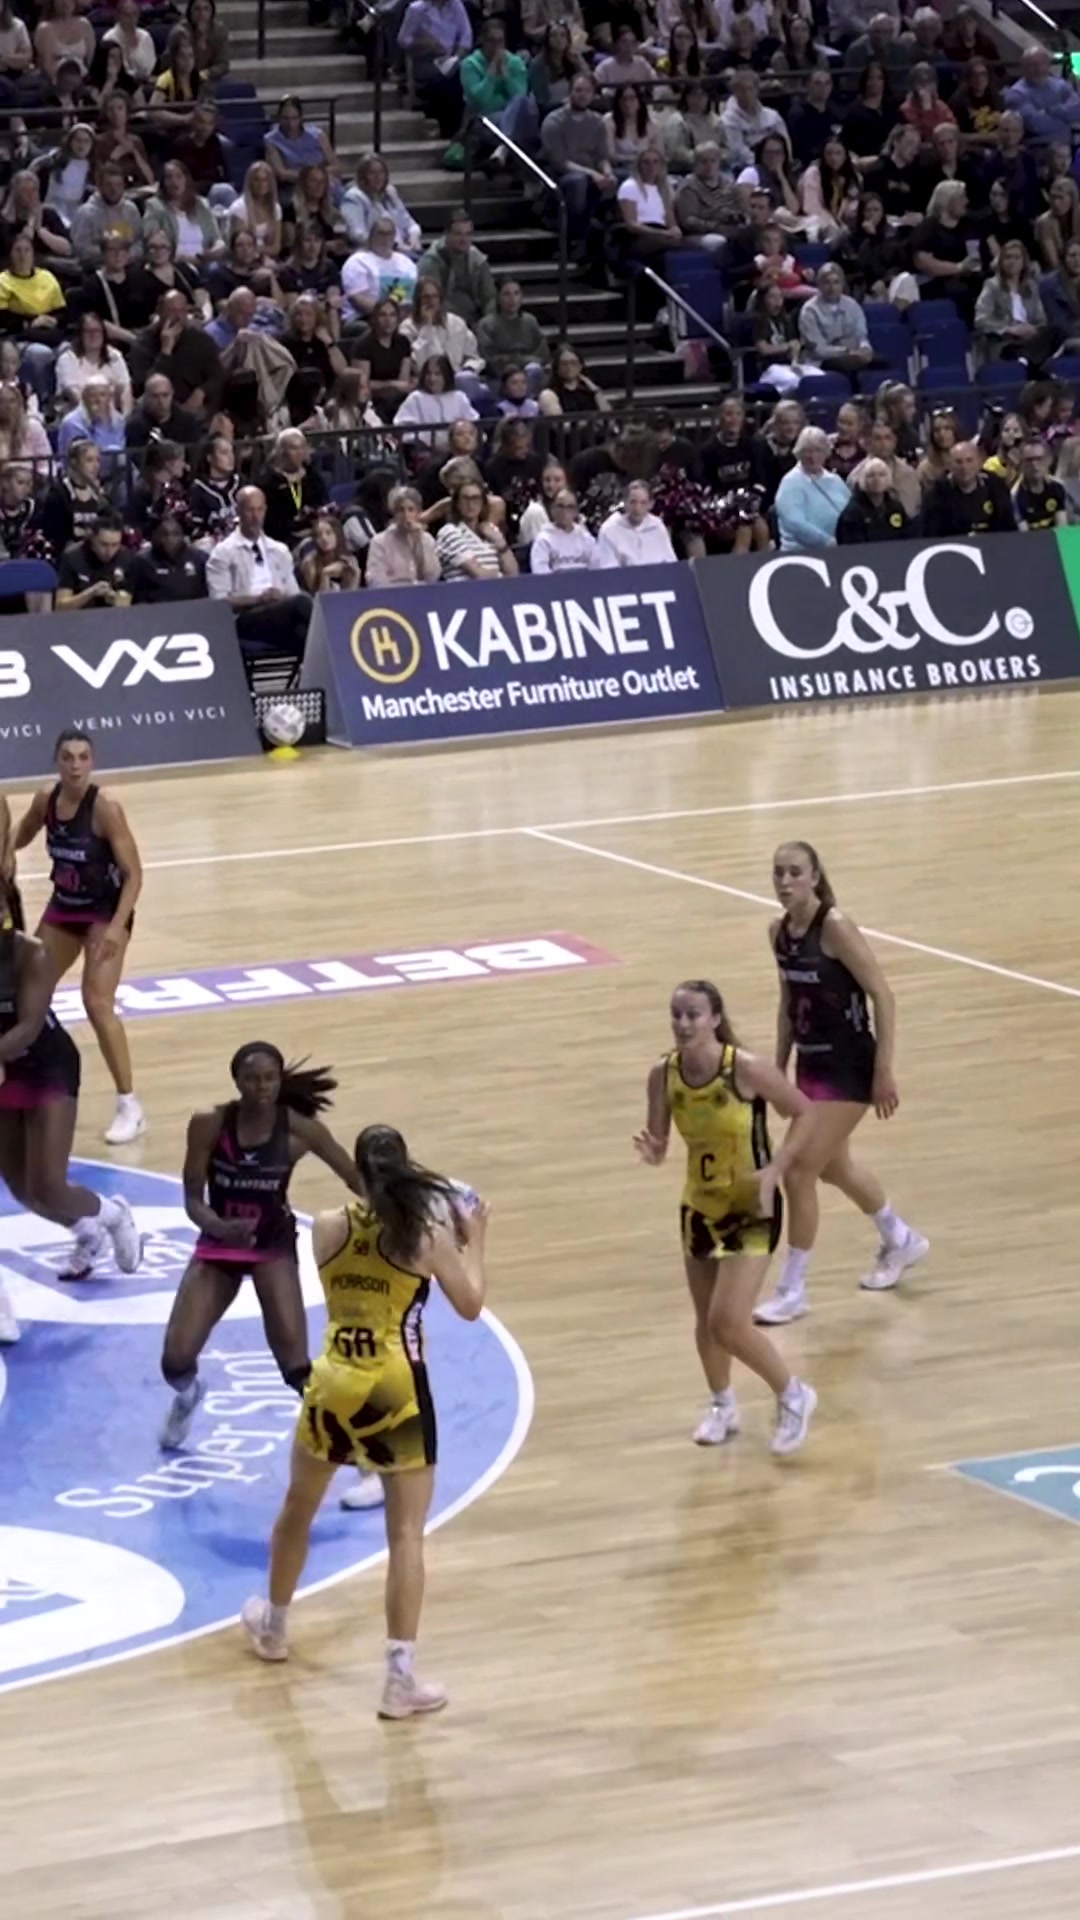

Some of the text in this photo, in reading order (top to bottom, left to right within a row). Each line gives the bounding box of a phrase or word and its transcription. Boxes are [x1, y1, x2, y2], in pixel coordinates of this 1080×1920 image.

[427, 591, 677, 670] KABINET
[50, 633, 214, 689] VX3
[770, 654, 1041, 700] INSURANCE BROKERS
[361, 665, 699, 720] Manchester Furniture Outlet
[0, 724, 42, 739] VICI
[73, 706, 226, 731] VENI VIDI VICI
[700, 1153, 716, 1182] C
[54, 1423, 290, 1518] Super
